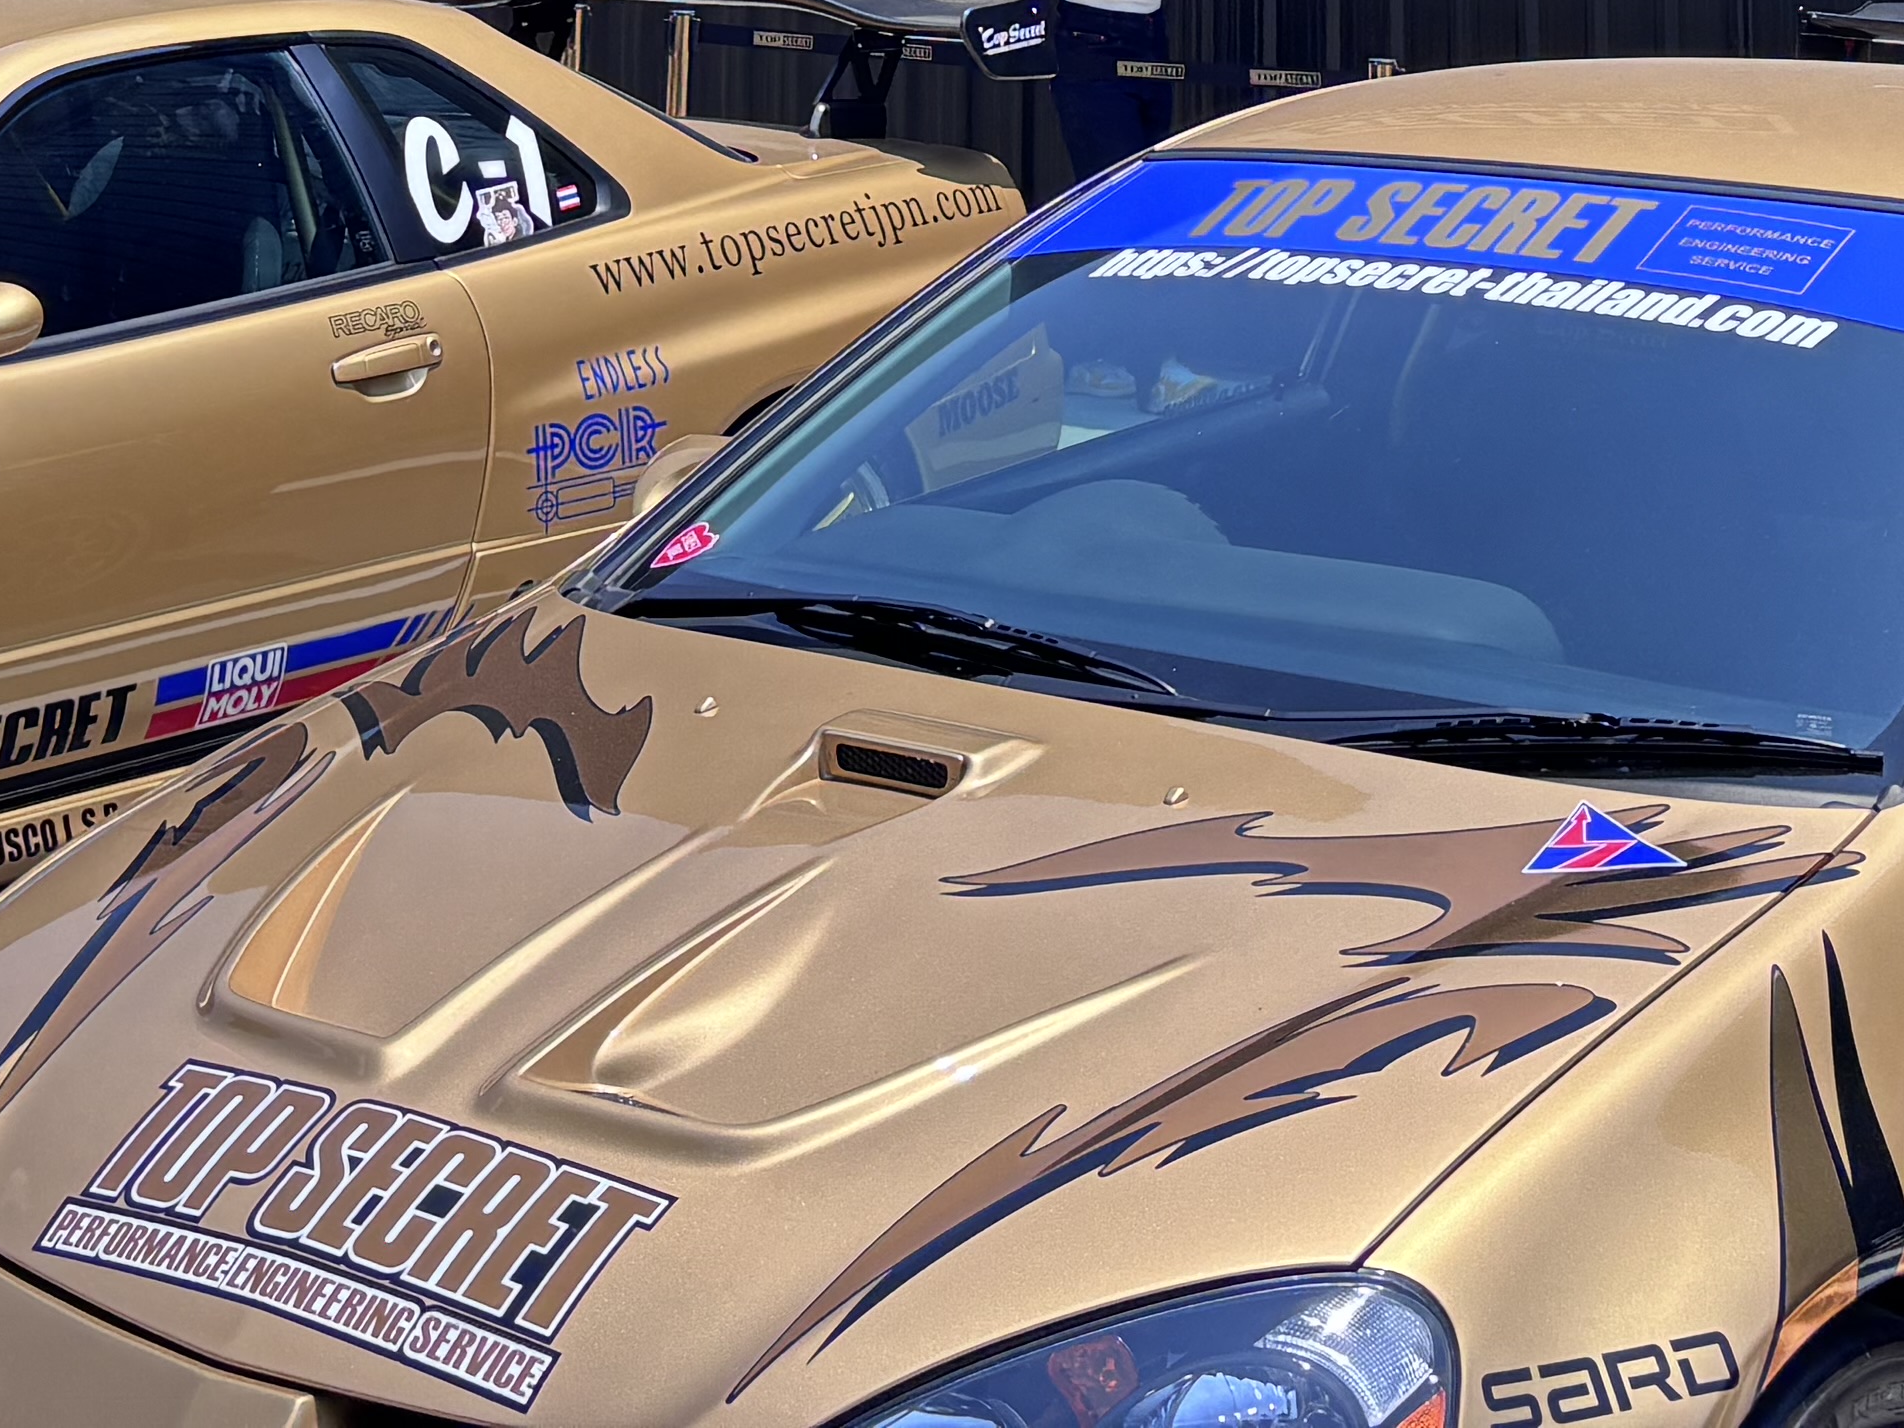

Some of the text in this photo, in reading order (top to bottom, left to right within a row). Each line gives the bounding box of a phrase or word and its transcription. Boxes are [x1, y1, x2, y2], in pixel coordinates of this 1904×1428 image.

[589, 180, 1004, 296] www.topsecretjpn.com
[1189, 177, 1661, 264] TOP SECRET
[1685, 217, 1837, 251] PERFORMANCE
[1678, 236, 1813, 266] ENGINEERING
[1689, 254, 1775, 277] SERVICE
[328, 299, 421, 339] RECARO
[1089, 245, 1839, 350] https://topsecret-thailand.com
[575, 345, 670, 402] ENDLESS
[526, 405, 668, 484] PCR
[208, 645, 285, 694] LIQUI
[200, 679, 280, 725] MOLY
[90, 1064, 668, 1336] TOP SECRET
[46, 1210, 546, 1398] PERFORMANCE ENGINEERING SERVICE
